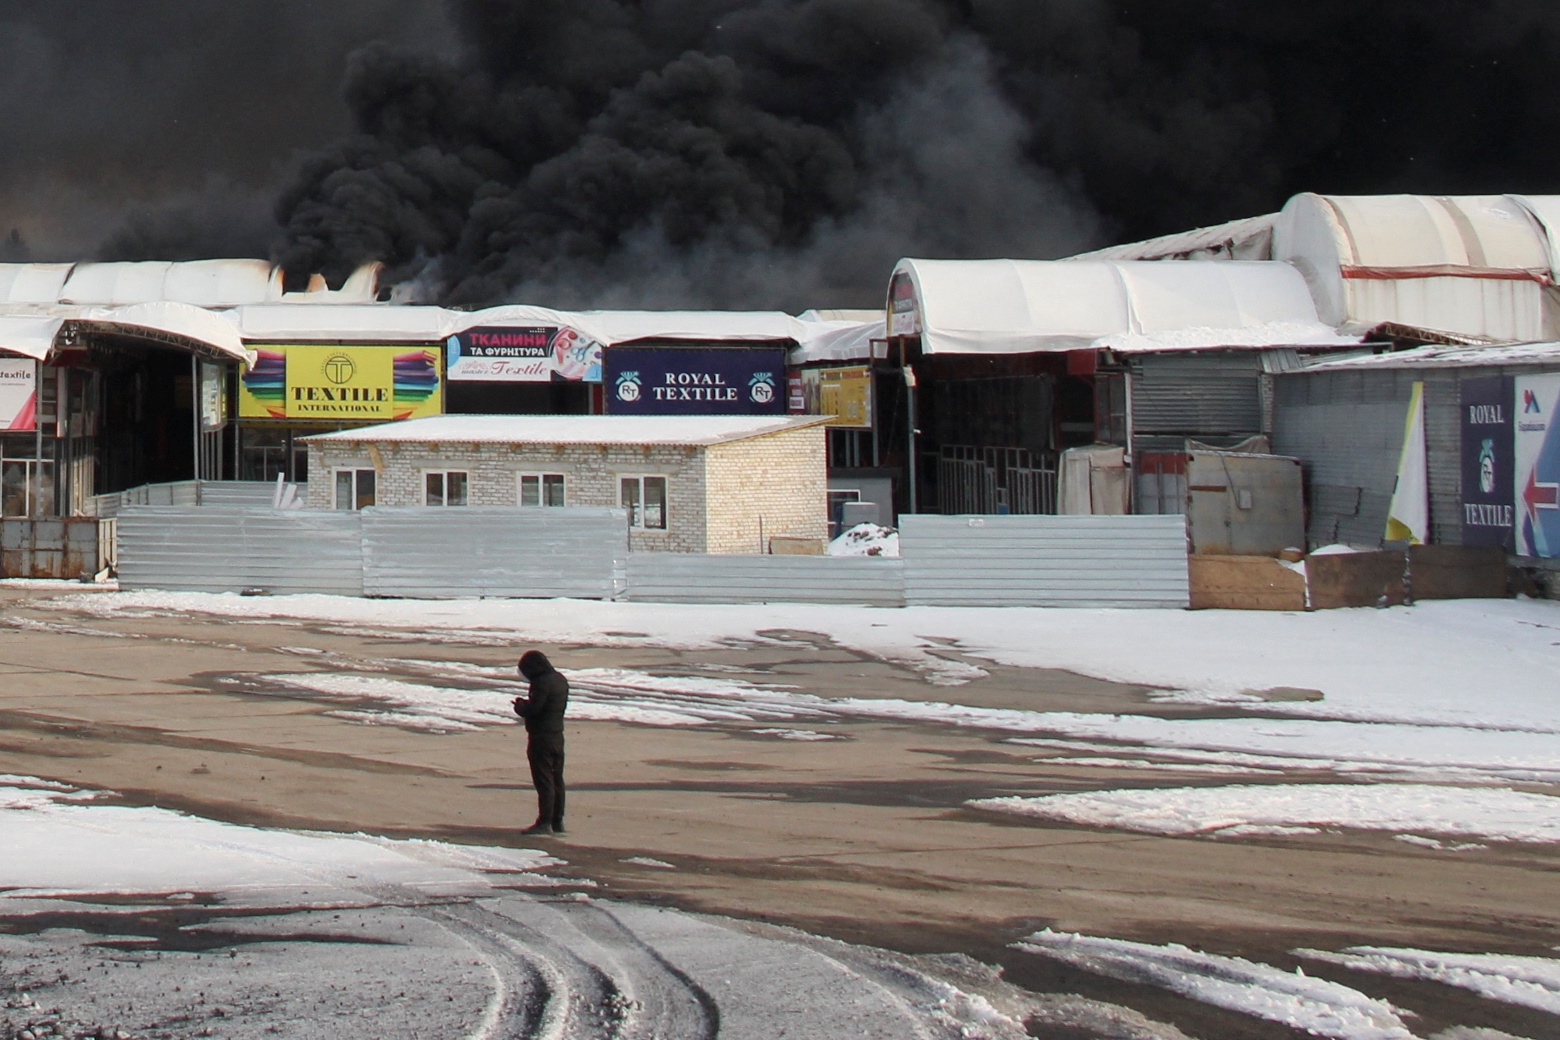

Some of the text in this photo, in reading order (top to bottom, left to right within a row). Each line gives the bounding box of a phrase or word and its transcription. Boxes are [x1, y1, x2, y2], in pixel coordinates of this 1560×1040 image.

[468, 333, 547, 346] ТКАНИНИ
[470, 347, 545, 356] ТА ФУРНІТУРА
[491, 361, 547, 375] Textile
[665, 373, 725, 385] ROYAL
[291, 387, 389, 401] TEXTILE
[653, 386, 738, 400] TEXTILE
[298, 404, 382, 412] INTERNATIONAL
[1470, 405, 1504, 423] ROYAL
[1464, 504, 1512, 526] TEXTILE
